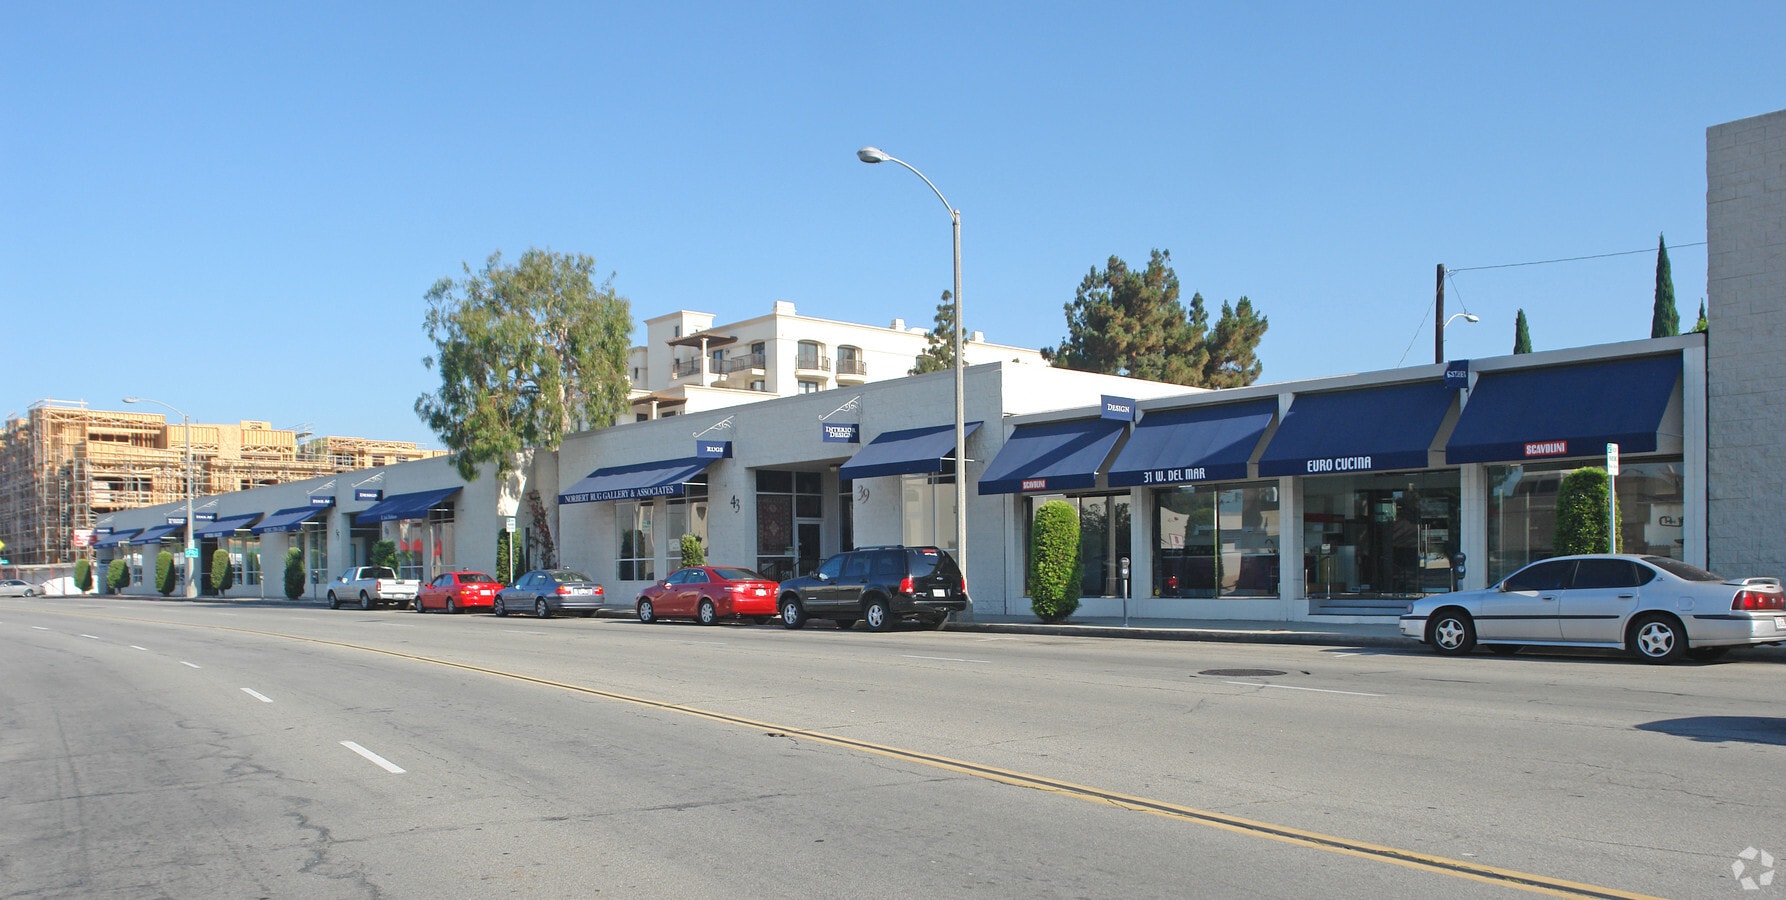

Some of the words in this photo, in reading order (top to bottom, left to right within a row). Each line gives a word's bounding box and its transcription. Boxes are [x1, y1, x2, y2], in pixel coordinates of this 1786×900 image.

[1107, 404, 1130, 414] DESIGN
[1526, 442, 1565, 455] SCAVOLINI
[1307, 459, 1333, 472] EURO
[1335, 456, 1372, 470] CUCINA
[1144, 472, 1152, 483] 31
[1155, 471, 1166, 482] W.
[1168, 469, 1184, 481] DEL
[1185, 467, 1206, 480] MAR
[565, 493, 590, 503] NORBERT
[590, 491, 602, 501] RUG
[602, 490, 630, 500] GALLERY
[630, 489, 635, 497] &
[636, 485, 674, 497] ASSOCIATES
[858, 485, 870, 504] 39
[731, 495, 740, 513] 43
